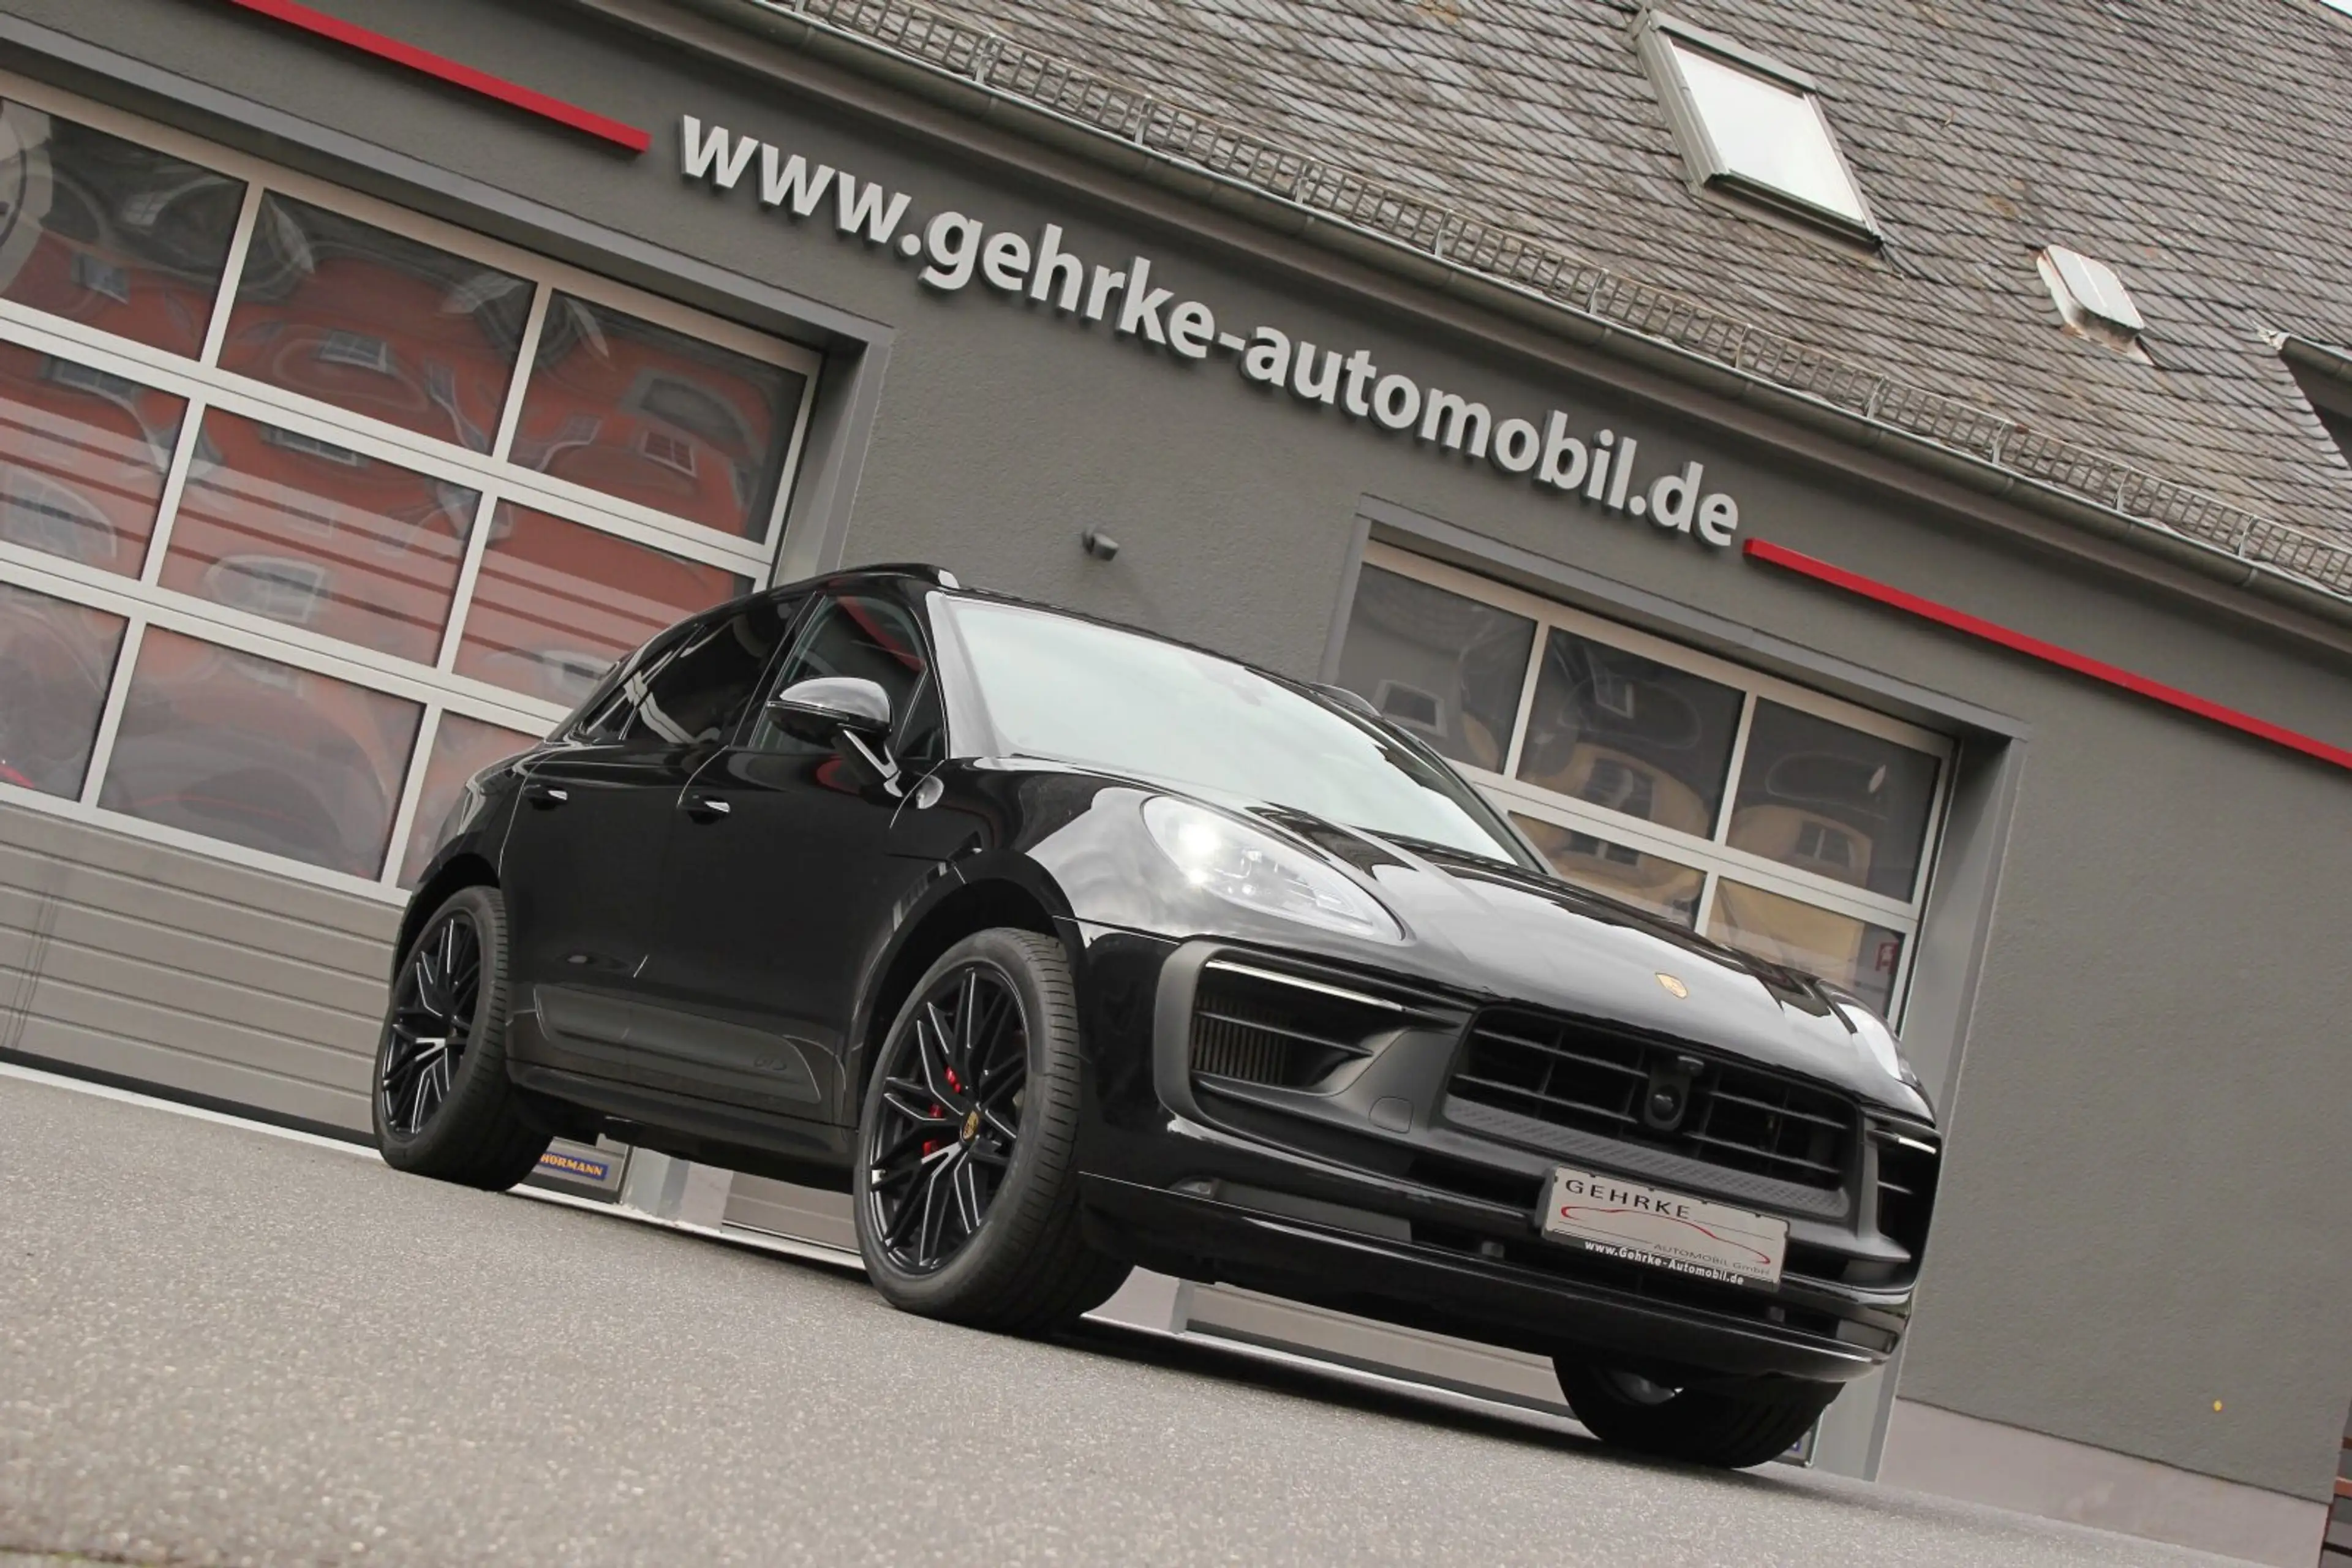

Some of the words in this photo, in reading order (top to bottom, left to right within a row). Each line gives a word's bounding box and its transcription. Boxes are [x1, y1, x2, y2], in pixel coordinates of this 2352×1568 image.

[682, 114, 1739, 546] www.gehrke-automobil.de
[1566, 1179, 1691, 1219] GEHRKE
[1584, 1241, 1744, 1285] www.Gehrke-Automobil.de
